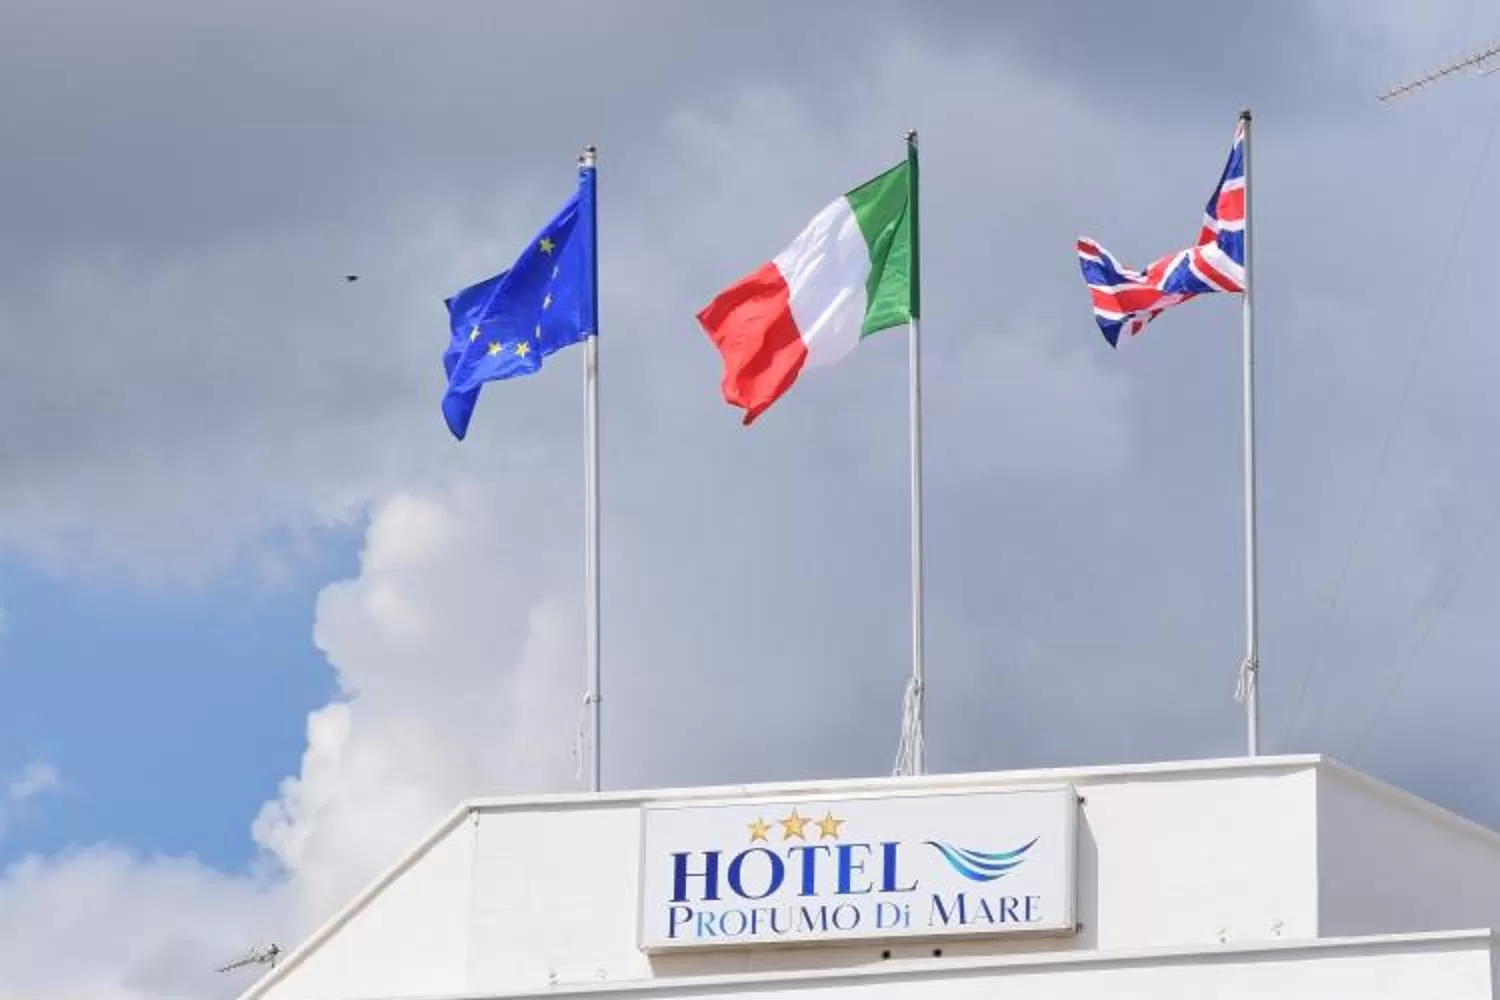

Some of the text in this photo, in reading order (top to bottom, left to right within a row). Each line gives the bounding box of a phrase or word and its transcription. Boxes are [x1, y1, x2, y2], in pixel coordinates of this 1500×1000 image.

[668, 841, 919, 903] HOTEL
[664, 893, 1043, 939] PROFUMO Di MARE
